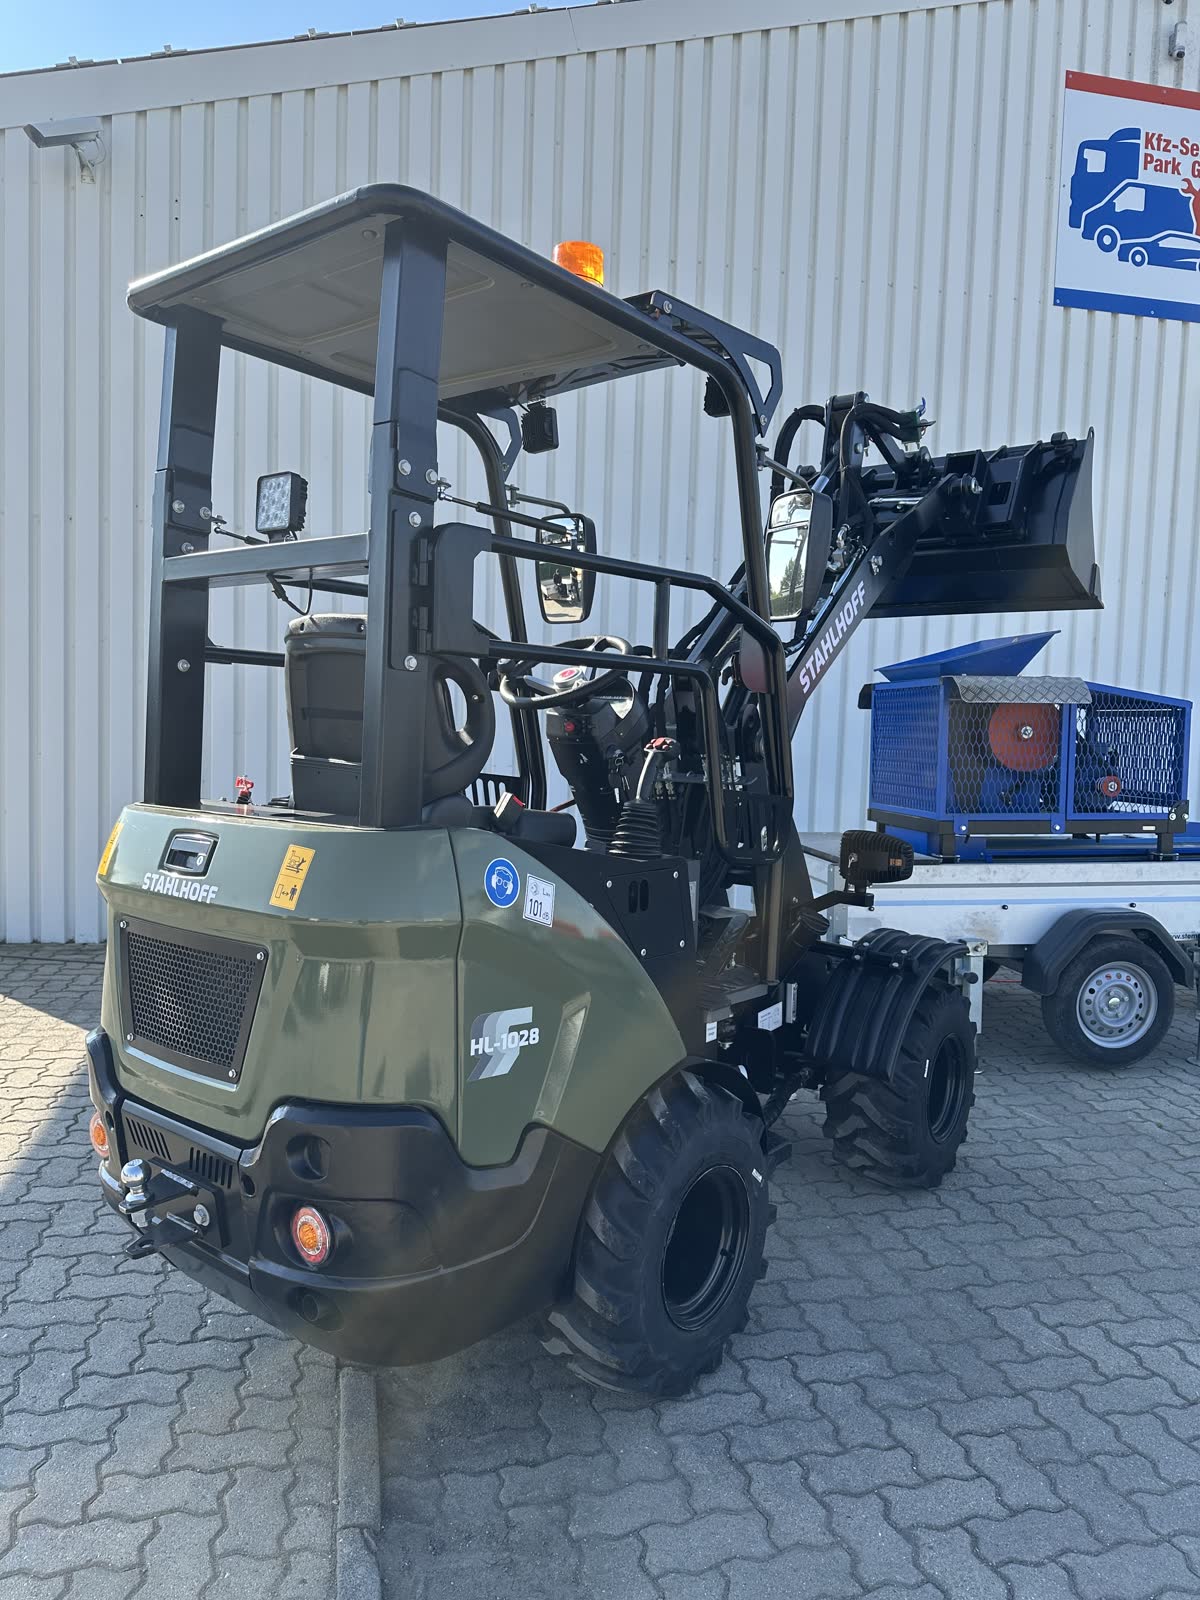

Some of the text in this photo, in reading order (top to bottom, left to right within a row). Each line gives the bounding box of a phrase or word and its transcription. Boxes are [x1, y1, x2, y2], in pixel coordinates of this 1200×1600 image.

[1143, 152, 1182, 176] Park
[799, 580, 866, 694] STAHLHOFF
[141, 872, 219, 904] STAHLHOFF
[529, 898, 543, 917] 101
[470, 1027, 540, 1057] HL-1028
